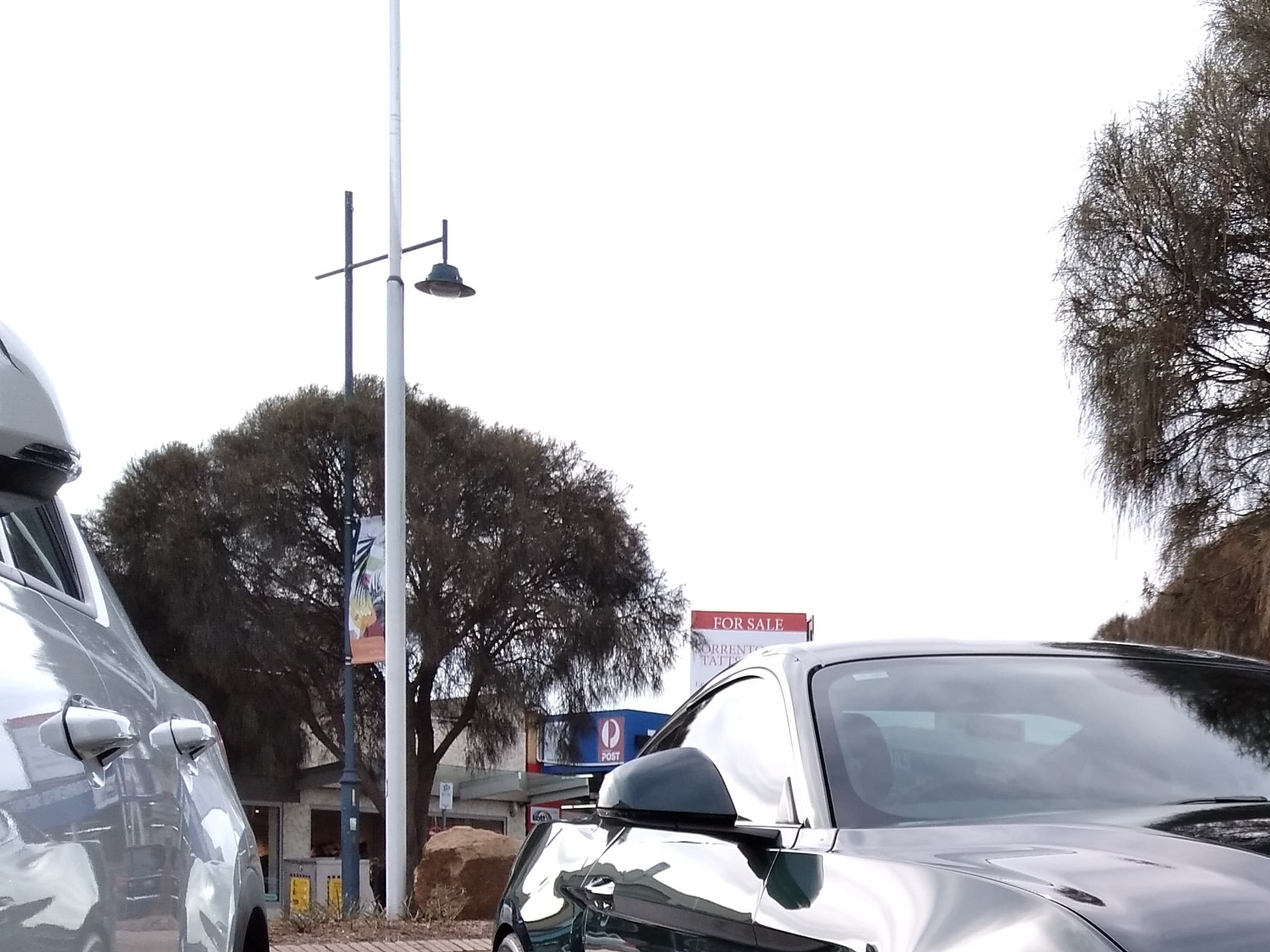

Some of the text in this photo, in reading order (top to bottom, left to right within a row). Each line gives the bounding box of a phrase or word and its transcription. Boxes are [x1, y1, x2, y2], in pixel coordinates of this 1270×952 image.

[713, 617, 784, 631] FOR SALE
[601, 751, 621, 762] POST
